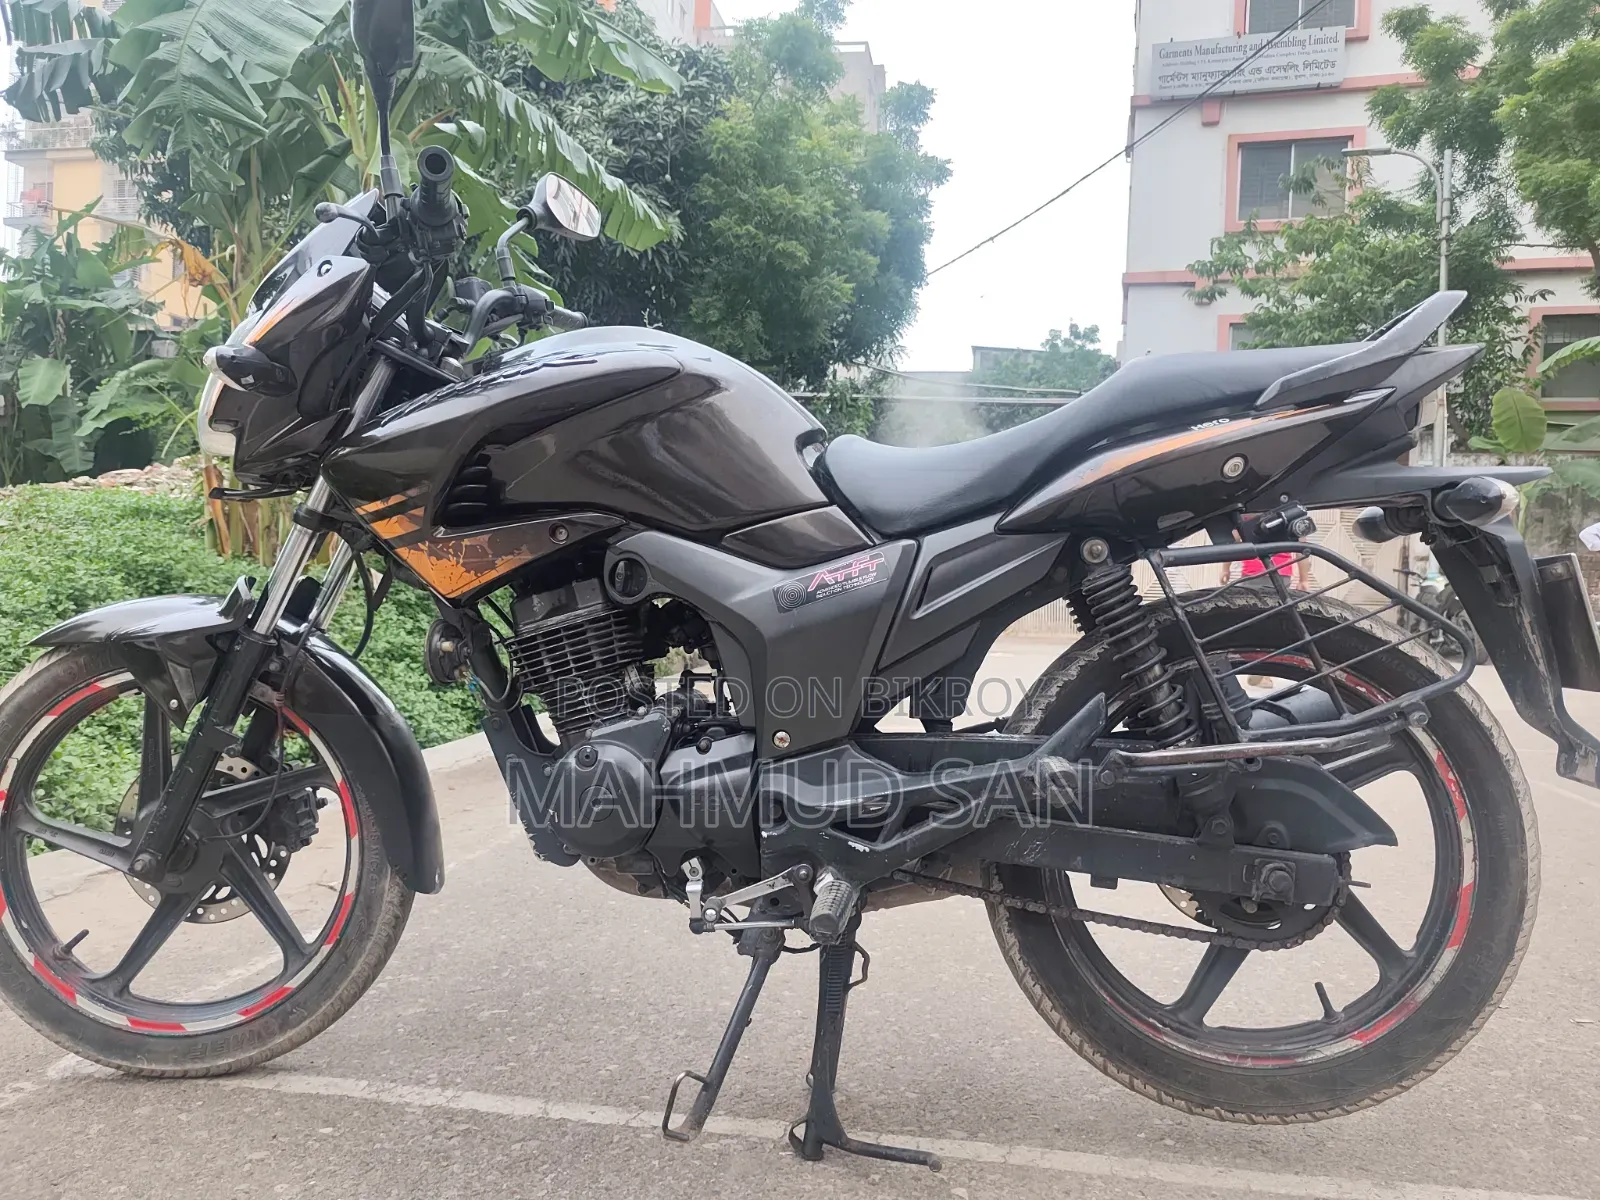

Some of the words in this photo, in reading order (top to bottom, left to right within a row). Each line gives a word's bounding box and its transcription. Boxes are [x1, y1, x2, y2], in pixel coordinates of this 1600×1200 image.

[1159, 47, 1193, 60] Garments
[1194, 42, 1248, 57] Manufacturing
[1249, 40, 1263, 52] and
[1264, 35, 1306, 50] Assembling
[1308, 32, 1340, 46] Limited.
[1190, 418, 1230, 431] Hero
